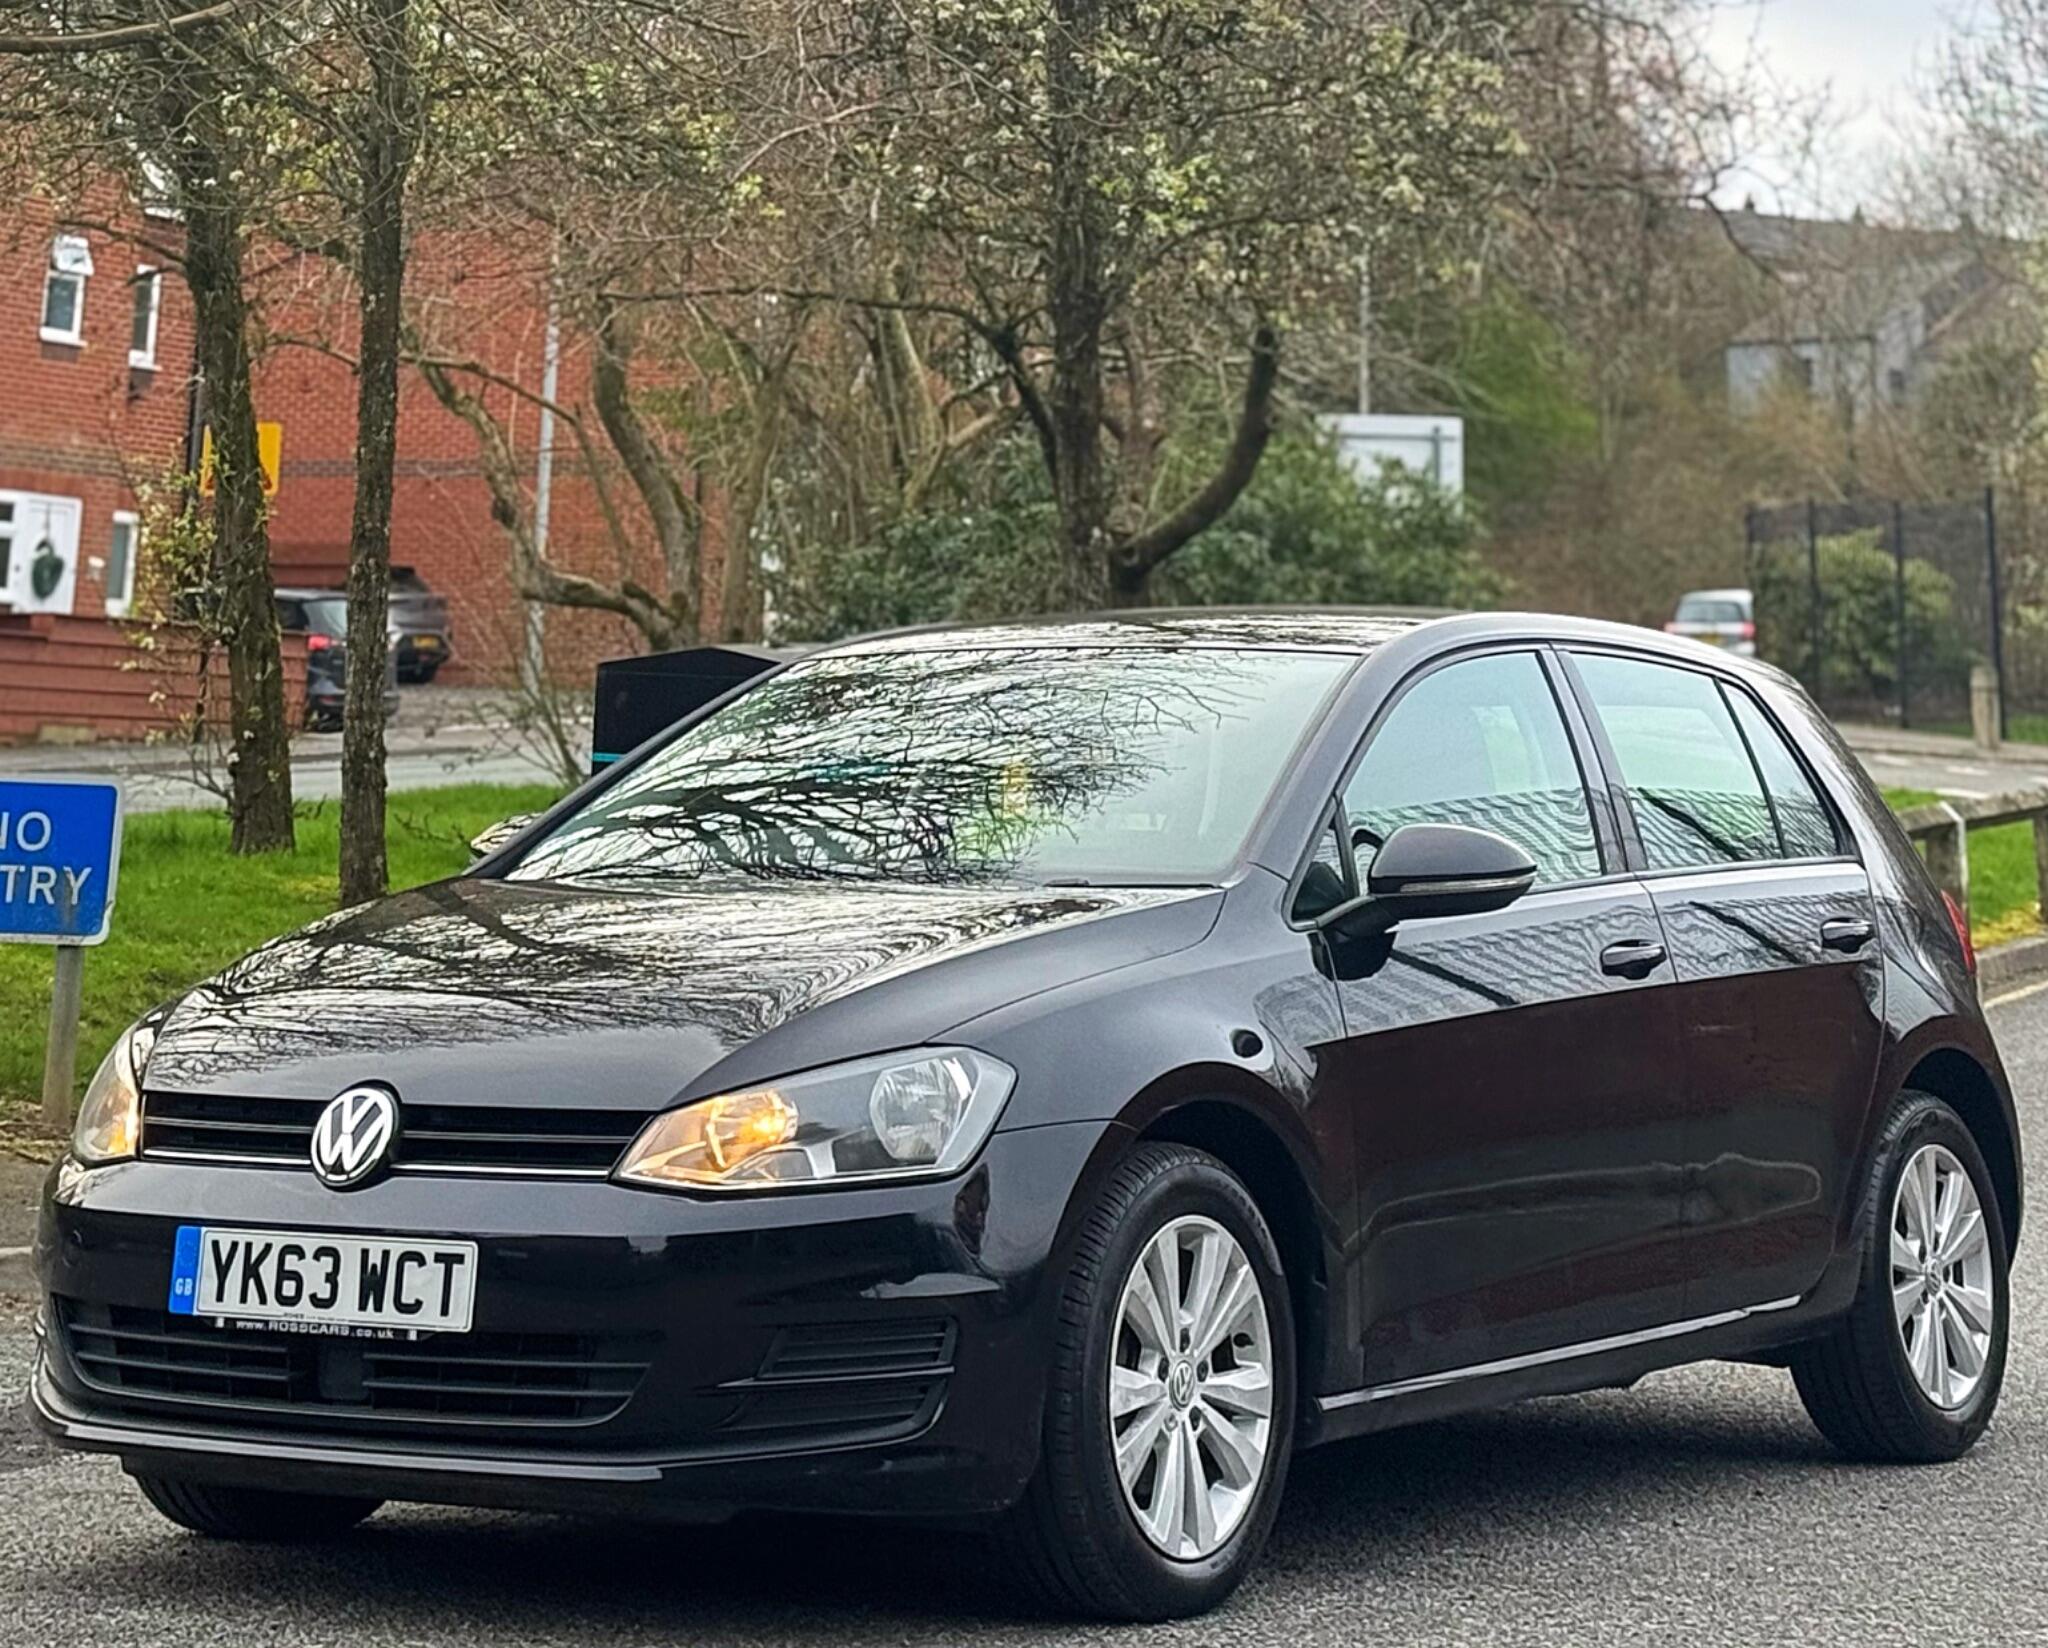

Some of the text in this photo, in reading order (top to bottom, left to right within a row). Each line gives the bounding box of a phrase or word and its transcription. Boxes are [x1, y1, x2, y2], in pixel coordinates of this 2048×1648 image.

[174, 1277, 193, 1296] GB
[211, 1239, 466, 1318] YK63 WCT
